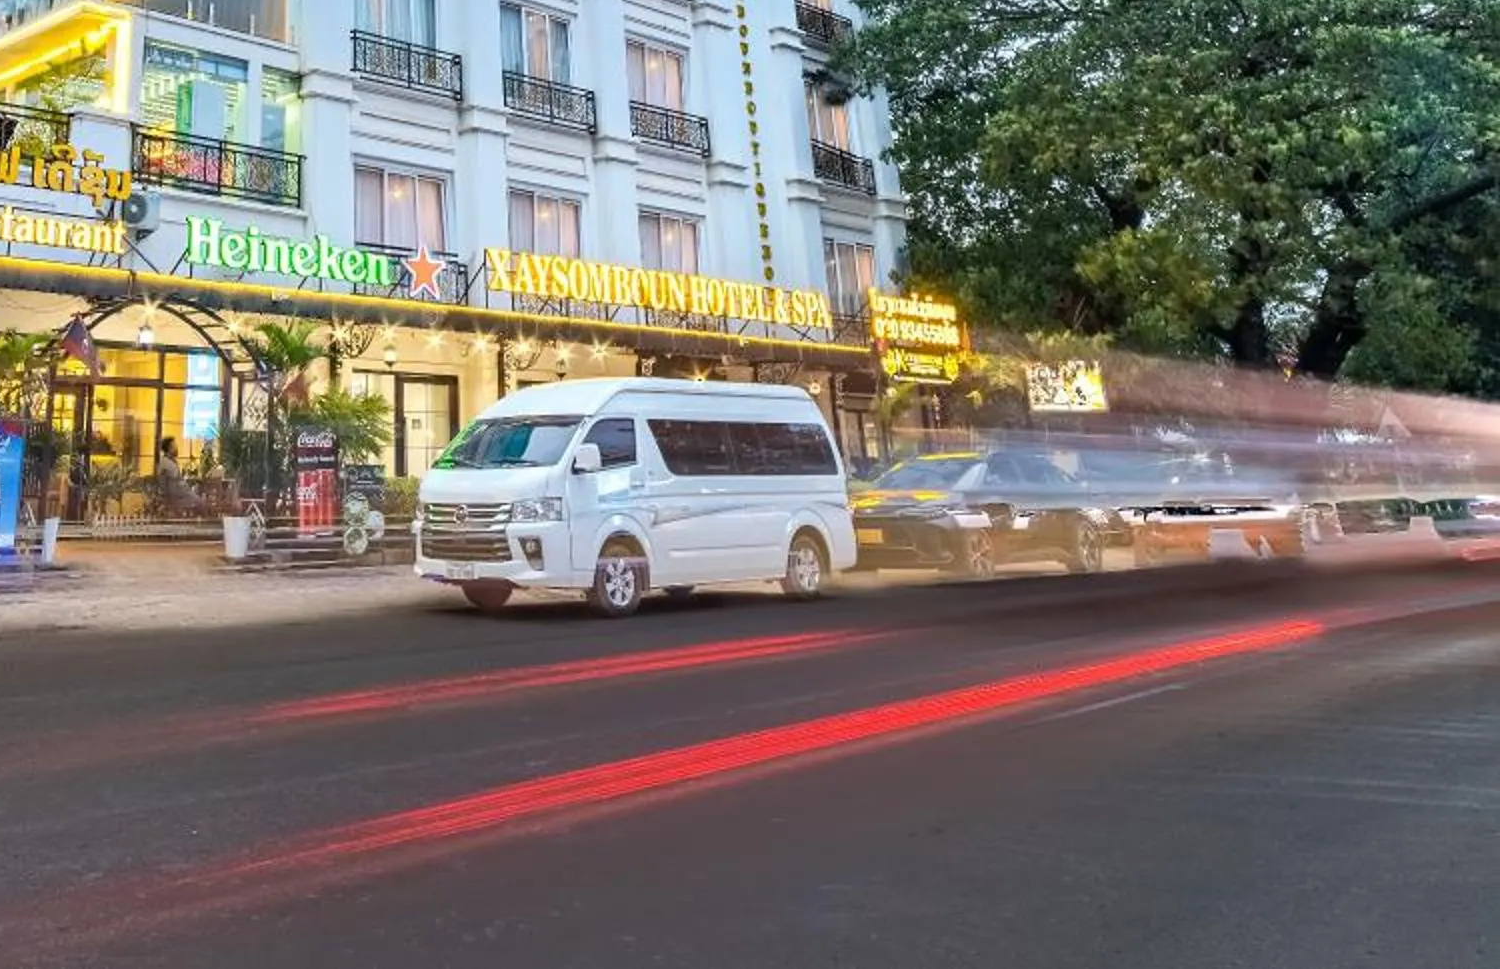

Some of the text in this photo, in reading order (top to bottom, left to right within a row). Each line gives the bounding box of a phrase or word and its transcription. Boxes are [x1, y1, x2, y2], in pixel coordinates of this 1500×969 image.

[185, 215, 391, 286] Heineken
[485, 247, 687, 311] XAYSOMBOUN
[689, 273, 773, 322] HOTEL
[773, 287, 791, 322] &
[791, 288, 834, 330] SPA
